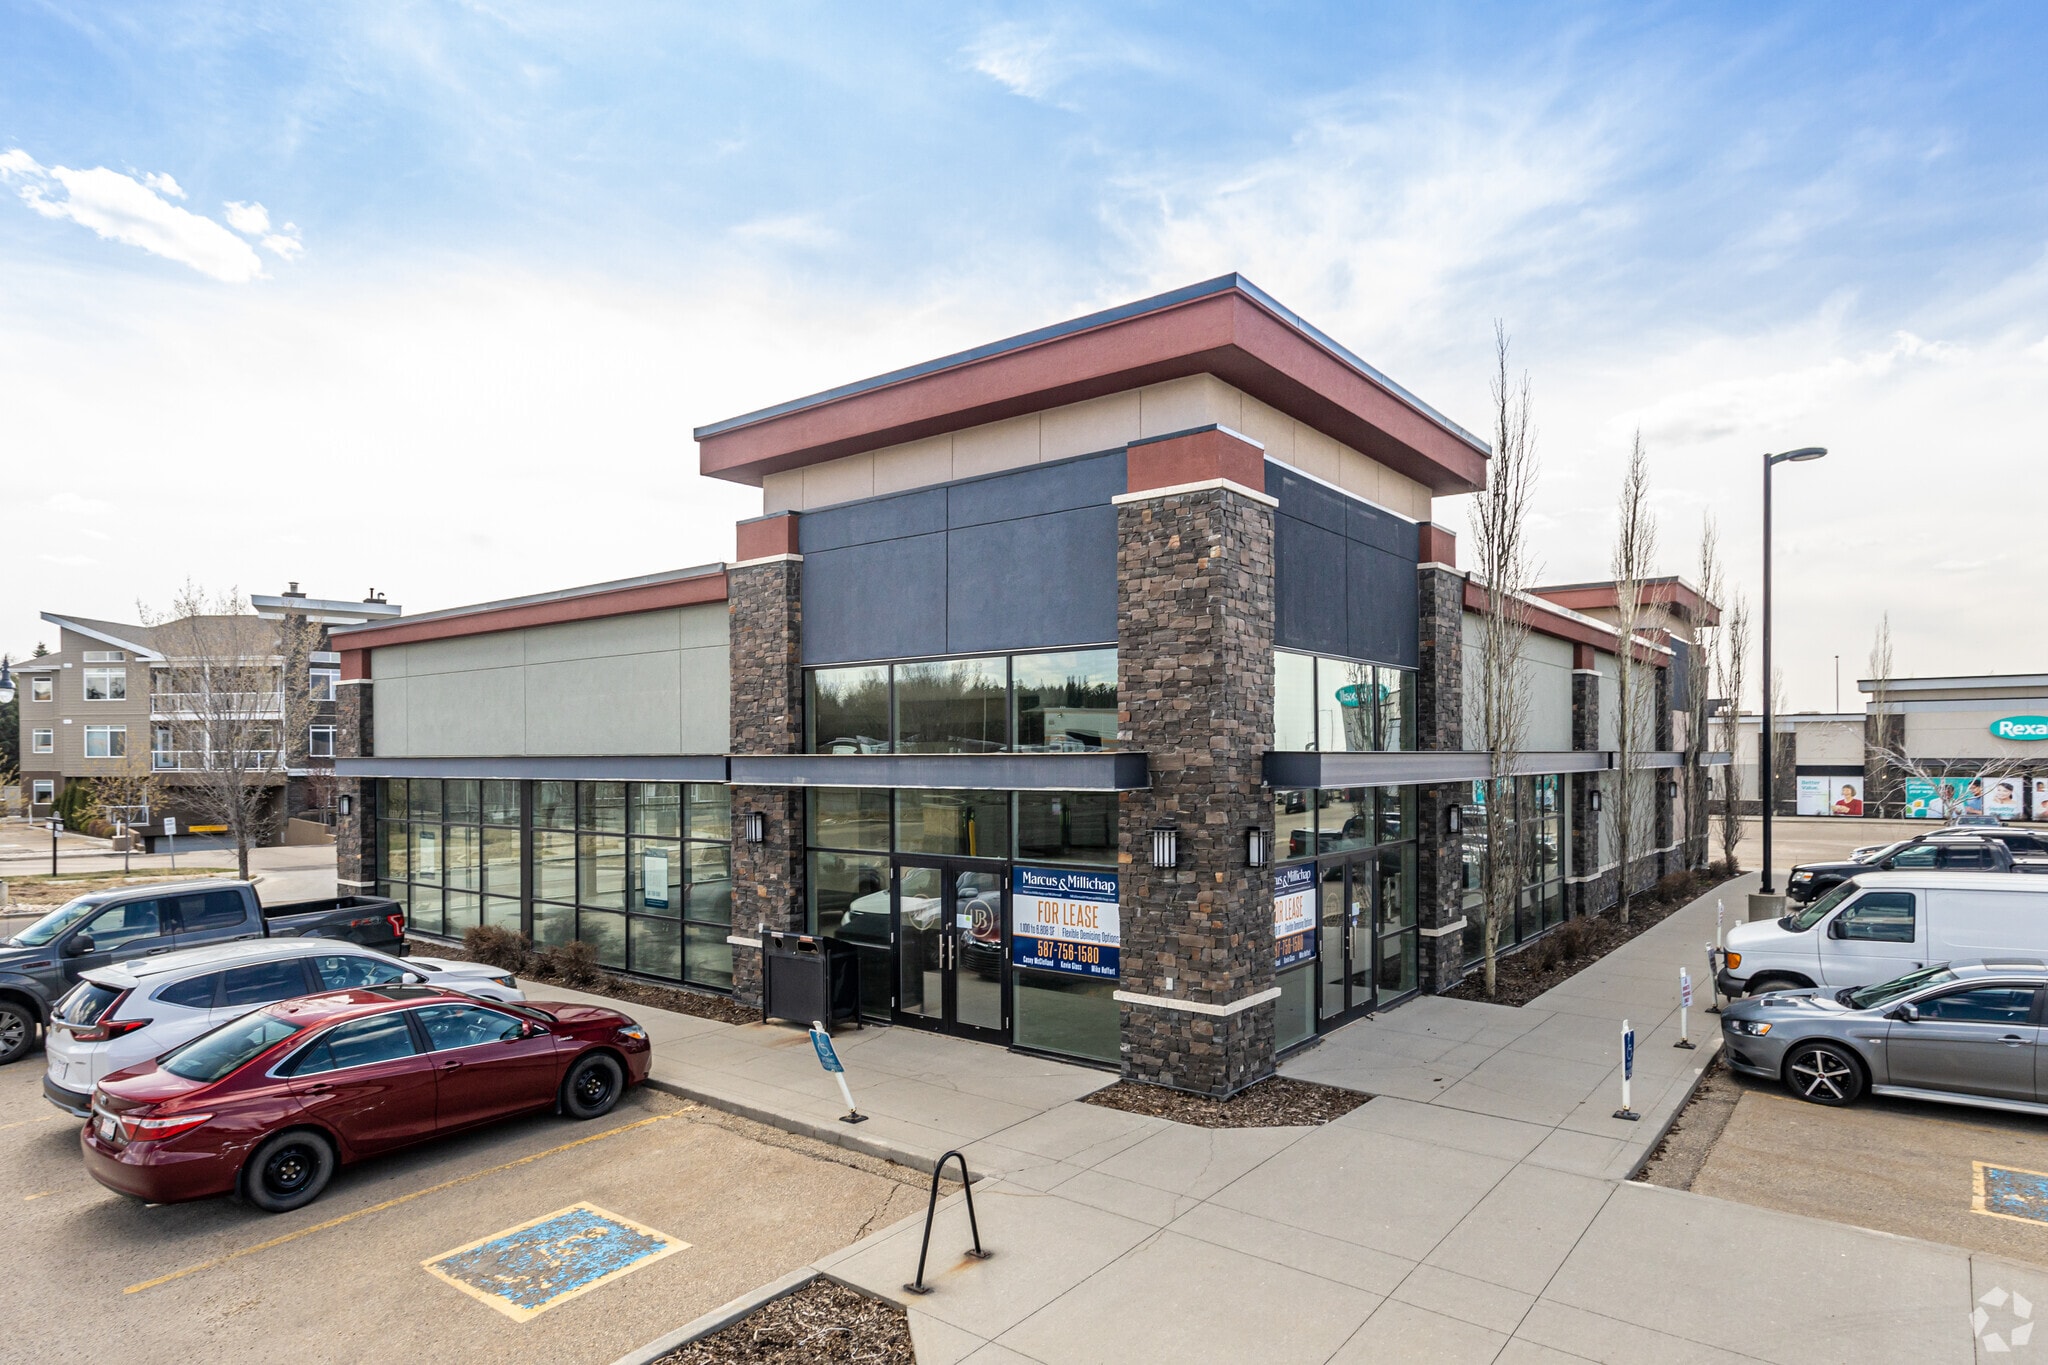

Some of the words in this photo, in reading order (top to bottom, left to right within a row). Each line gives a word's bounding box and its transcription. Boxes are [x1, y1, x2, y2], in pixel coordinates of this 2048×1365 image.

[2000, 721, 2048, 736] Rexa
[1023, 871, 1058, 887] Marcus
[1059, 878, 1069, 891] &
[1067, 874, 1115, 893] Millichap
[1037, 900, 1059, 924] FOR
[1063, 902, 1099, 928] LEASE
[1274, 900, 1283, 923] OR
[1284, 895, 1303, 921] LEASE
[1062, 927, 1080, 939] Flexible
[1037, 940, 1099, 964] 587-756-1580
